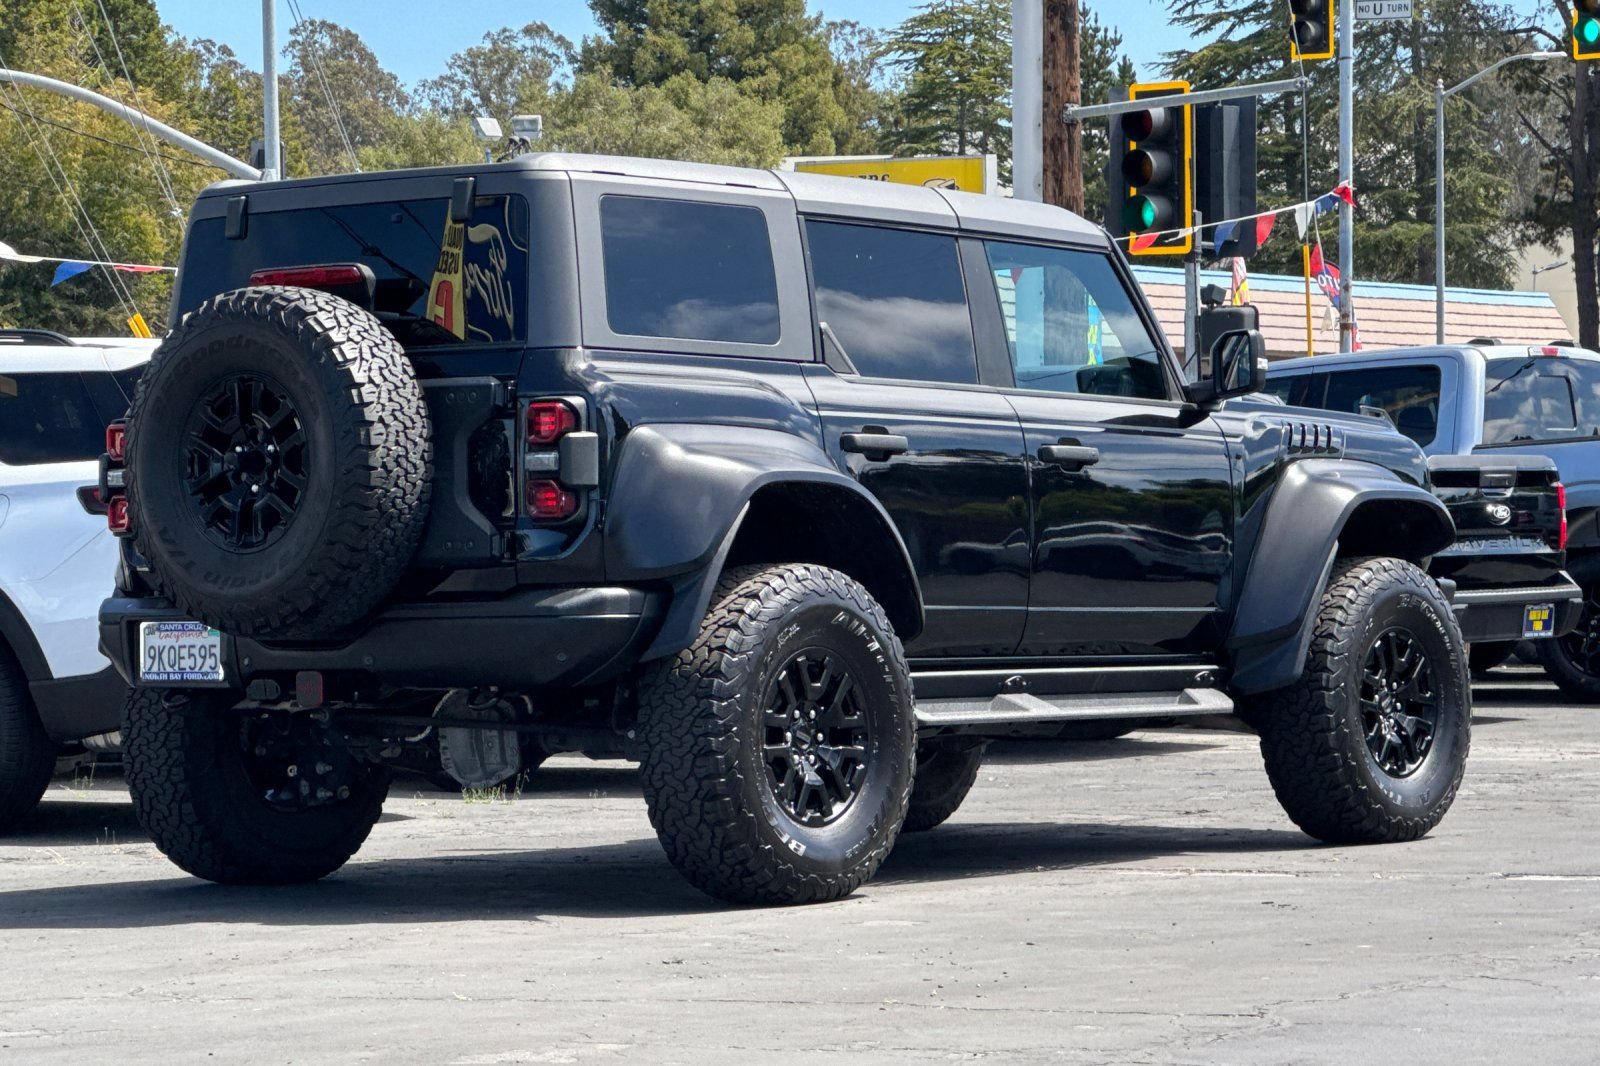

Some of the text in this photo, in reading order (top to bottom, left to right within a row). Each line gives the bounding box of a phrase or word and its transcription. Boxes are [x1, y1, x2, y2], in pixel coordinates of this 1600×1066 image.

[1358, 3, 1409, 15] NO U TURN
[147, 645, 218, 671] 9KQE595
